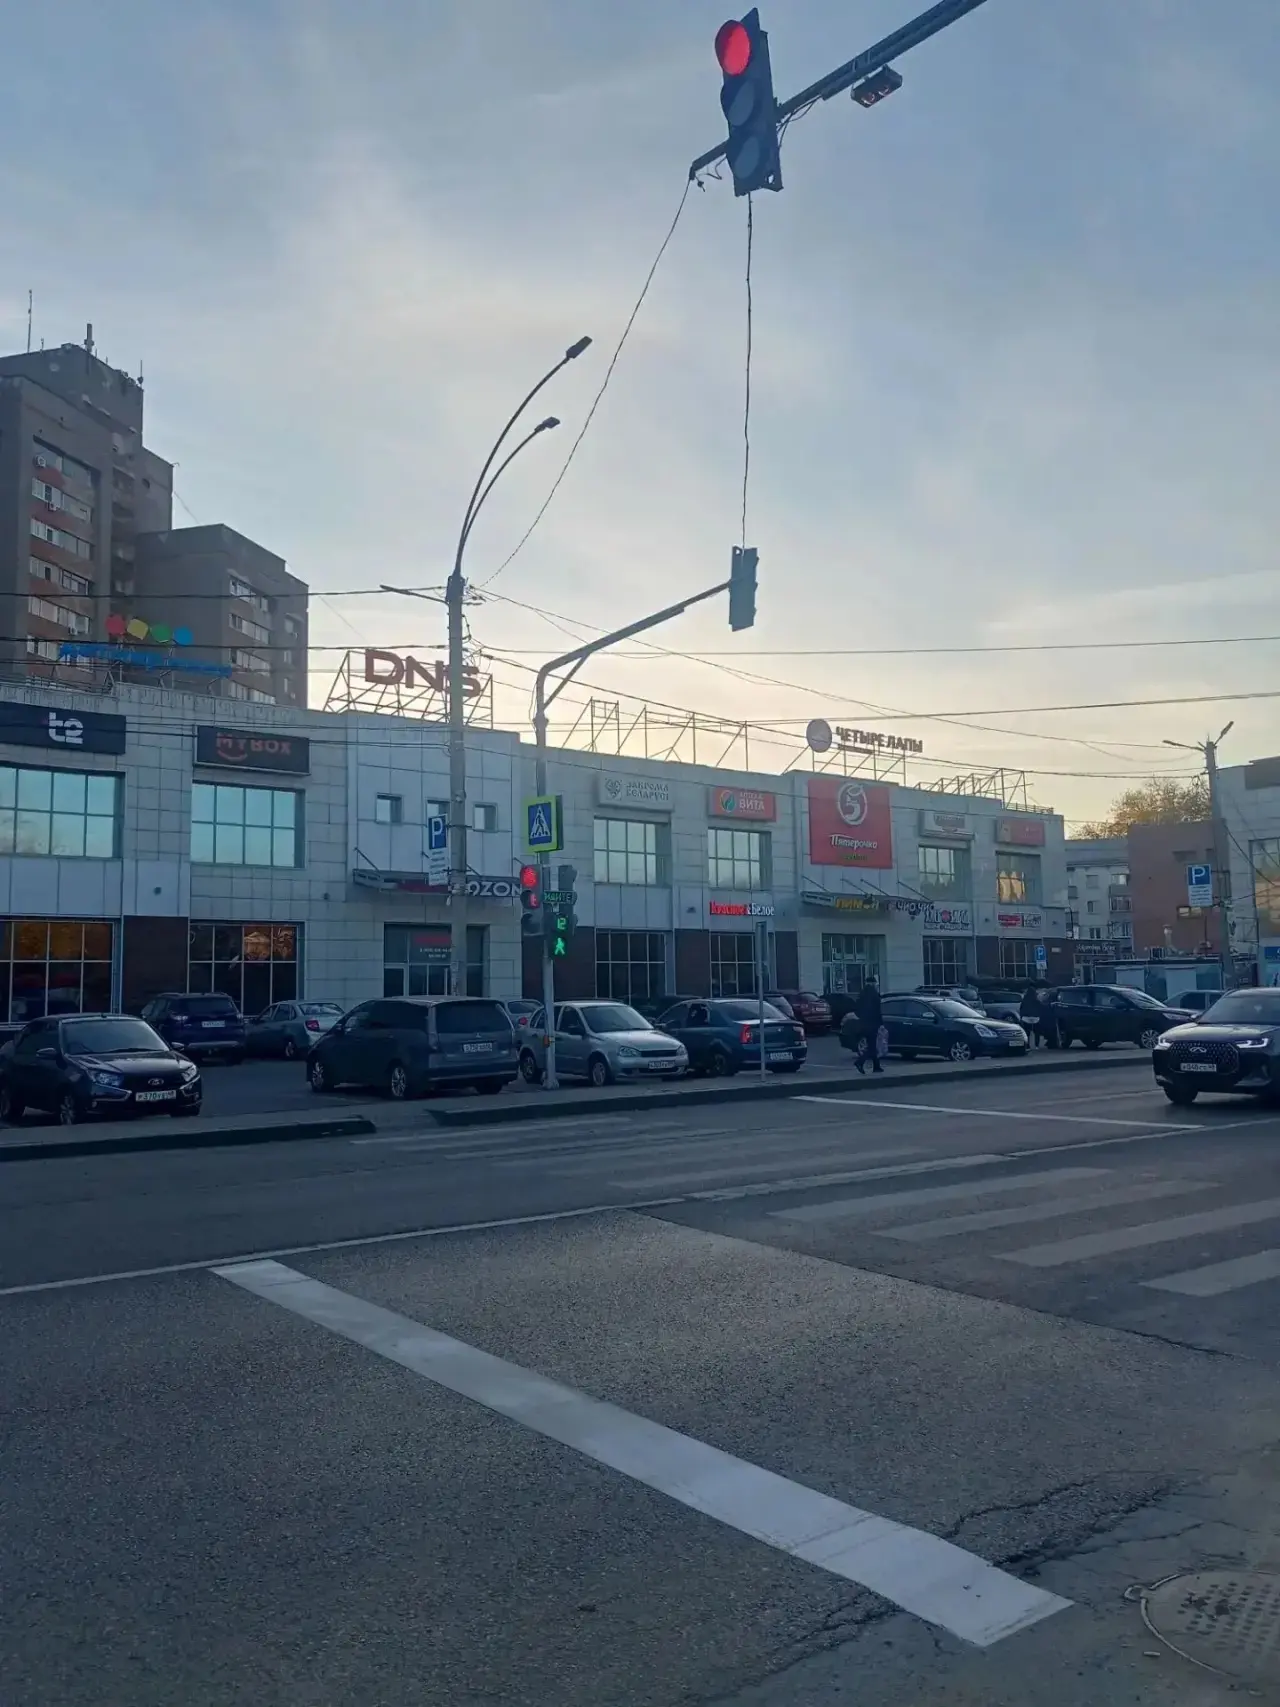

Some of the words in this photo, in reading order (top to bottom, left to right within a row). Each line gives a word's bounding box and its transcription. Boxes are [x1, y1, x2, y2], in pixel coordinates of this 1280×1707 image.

[364, 648, 481, 698] DNS
[836, 726, 885, 747] ЧЕТЫРЕ
[886, 735, 923, 753] ЛАПЫ
[739, 799, 765, 811] ВИТА
